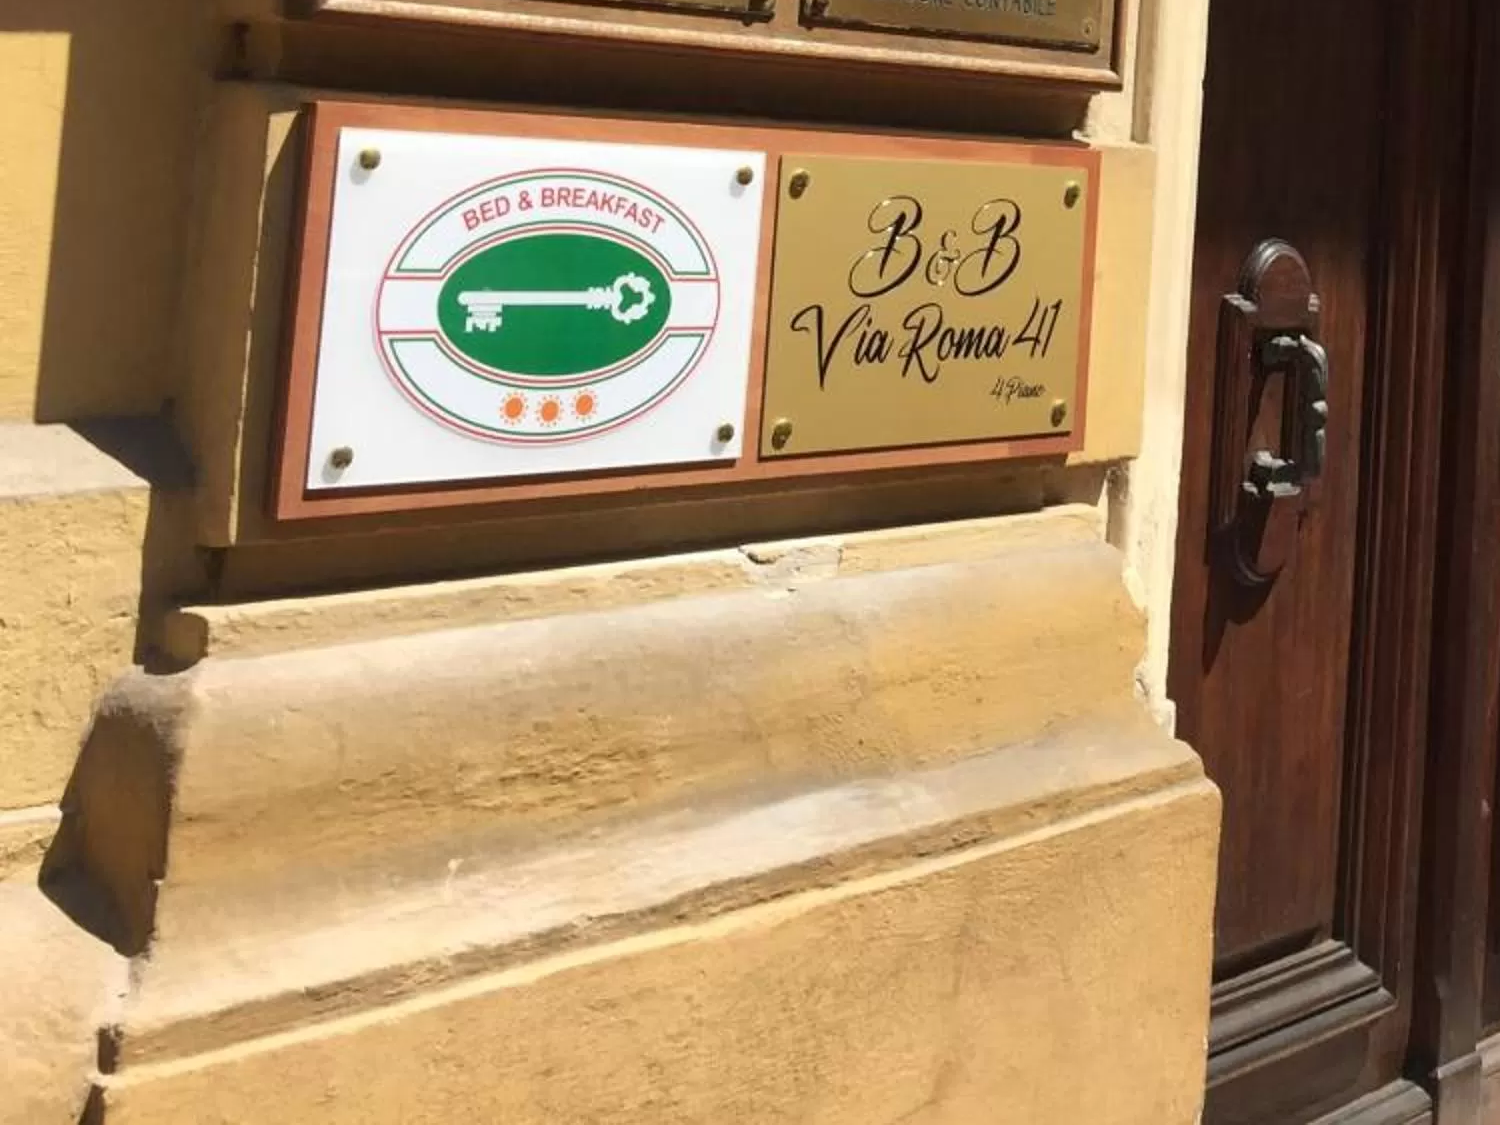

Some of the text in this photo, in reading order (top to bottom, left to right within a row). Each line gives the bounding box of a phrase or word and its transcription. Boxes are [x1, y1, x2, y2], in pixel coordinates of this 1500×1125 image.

[462, 187, 666, 235] BED & BREAKFAST
[790, 295, 1063, 391] Via Roma 41
